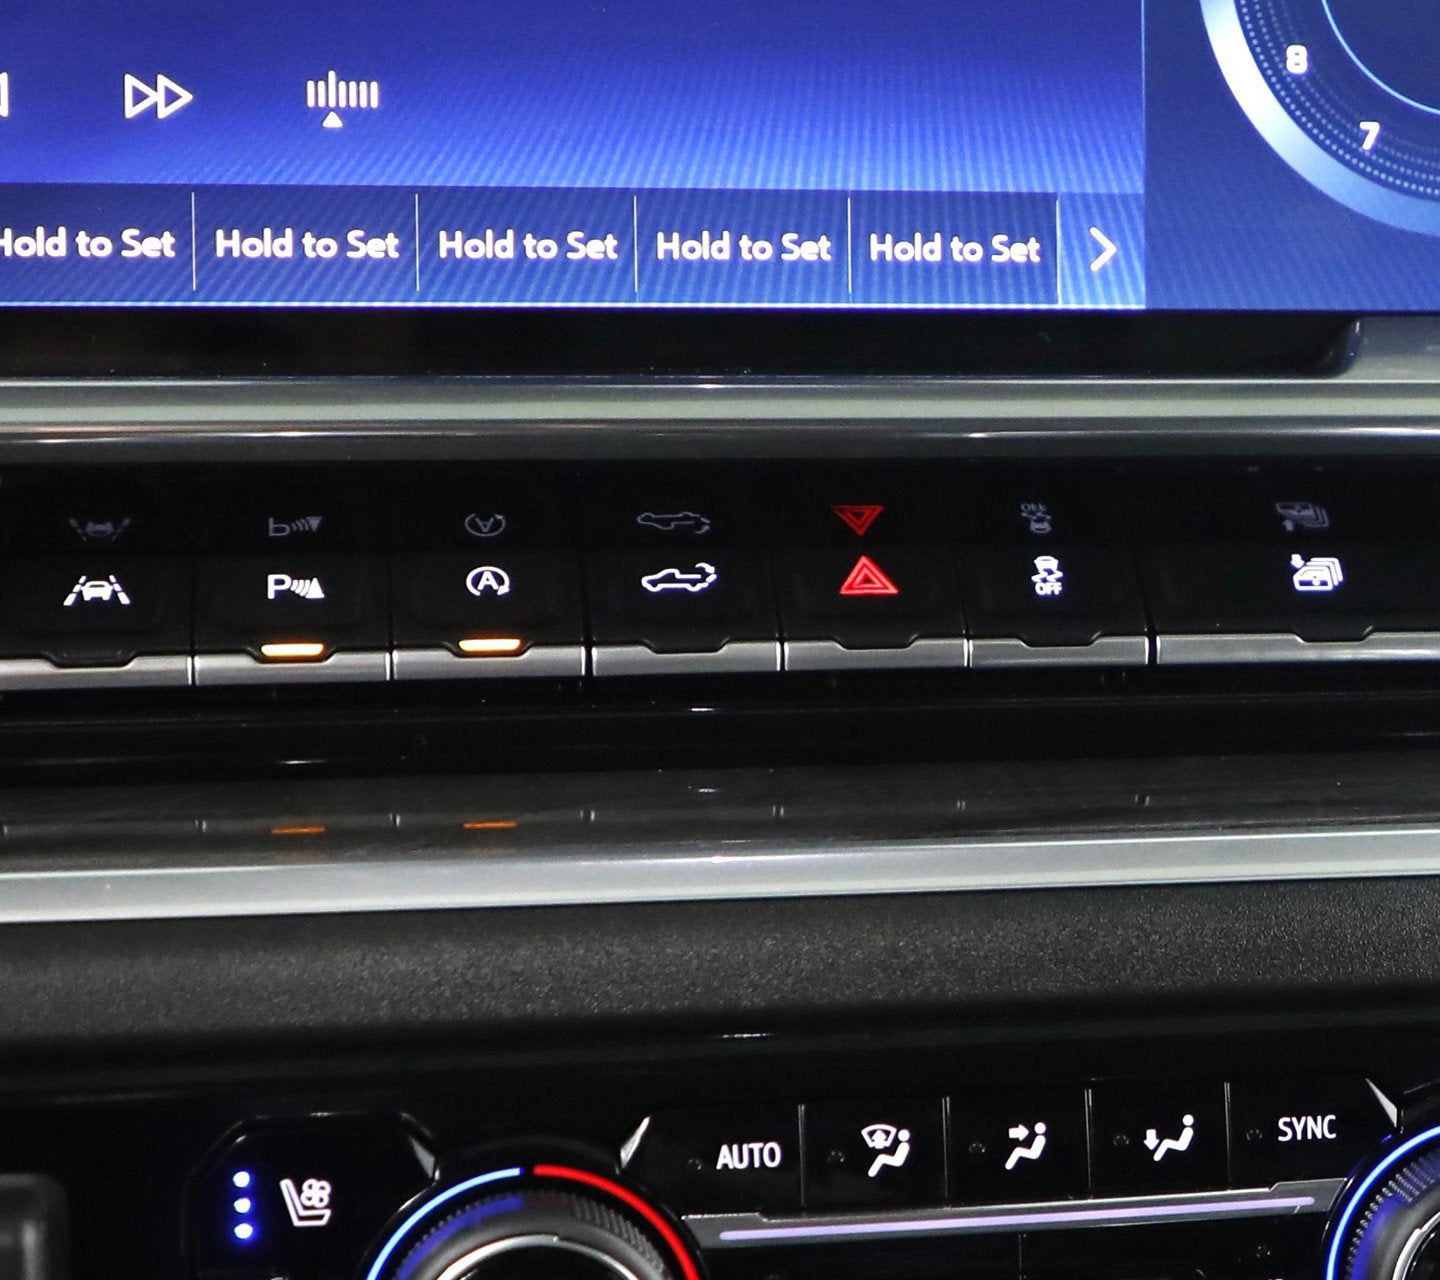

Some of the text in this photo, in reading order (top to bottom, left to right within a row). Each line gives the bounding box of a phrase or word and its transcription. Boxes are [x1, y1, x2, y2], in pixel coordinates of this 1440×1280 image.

[1285, 44, 1309, 75] 8
[1359, 121, 1381, 154] 7
[75, 230, 111, 258] to
[120, 228, 176, 259] Set
[215, 227, 400, 260] Hold to Set
[439, 228, 619, 261] Hold to Set
[656, 230, 833, 262] Hold to Set
[869, 231, 1041, 264] Hold to Set
[1034, 581, 1063, 596] OFF
[1277, 1114, 1337, 1142] SYNC
[715, 1141, 782, 1170] AUTO
